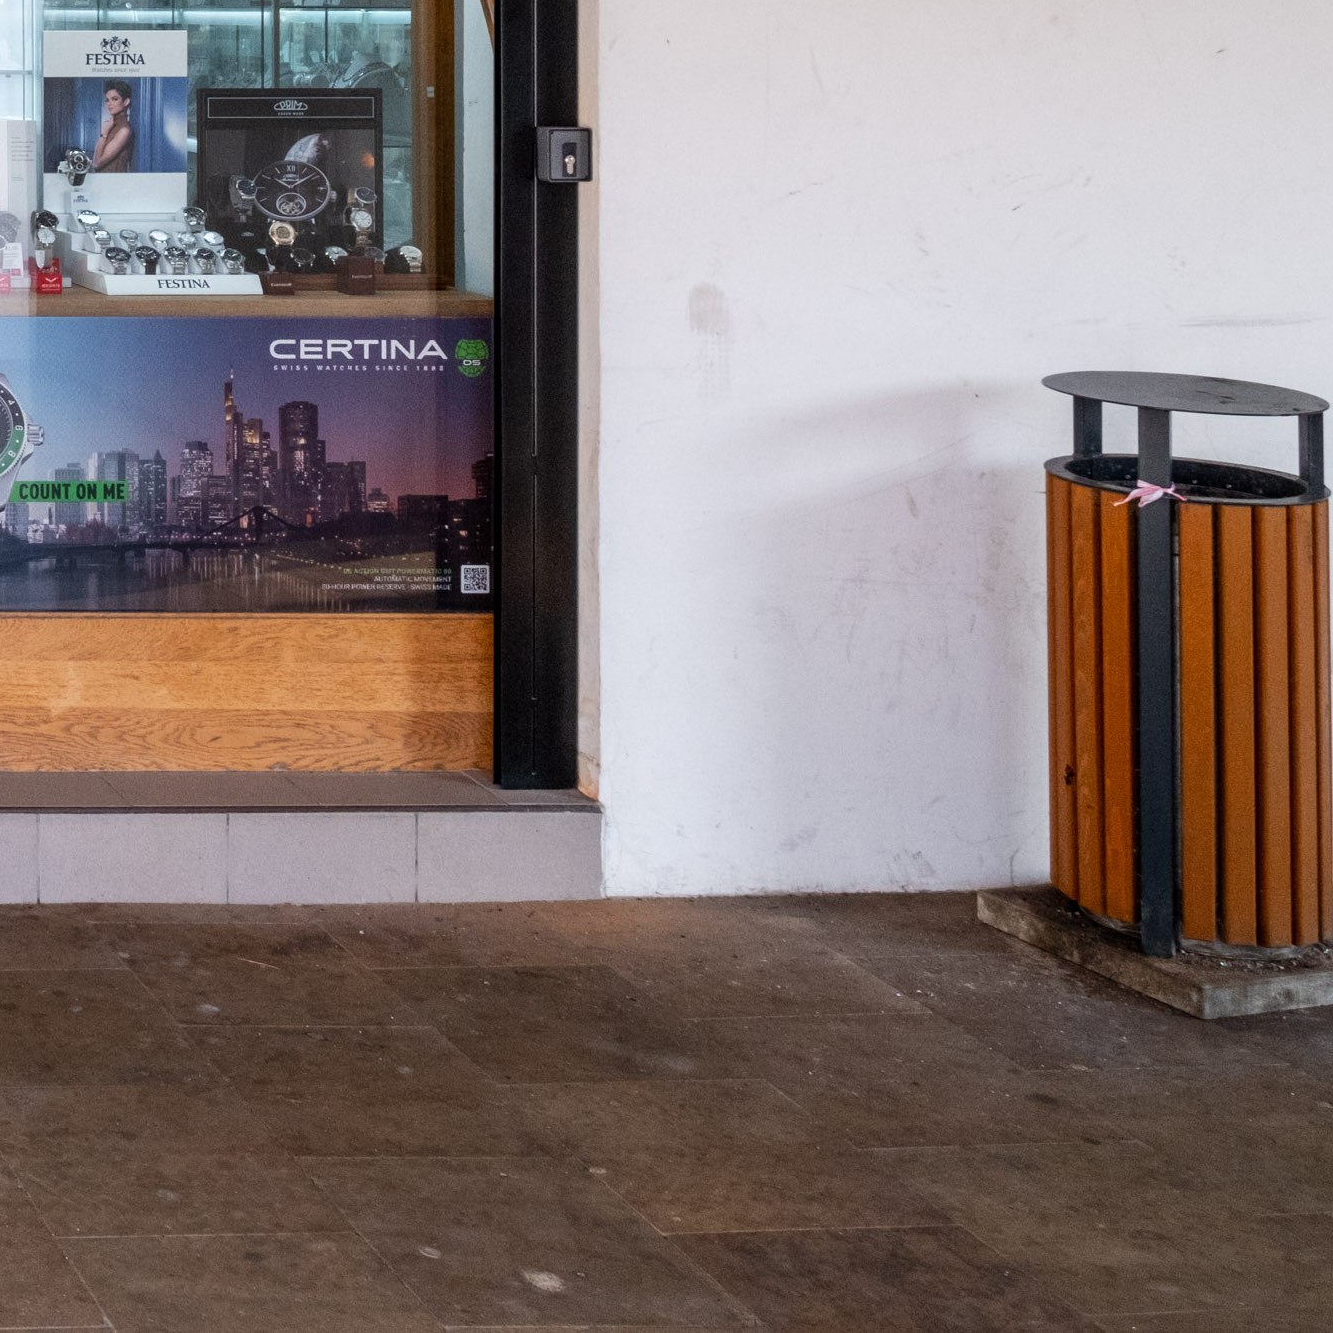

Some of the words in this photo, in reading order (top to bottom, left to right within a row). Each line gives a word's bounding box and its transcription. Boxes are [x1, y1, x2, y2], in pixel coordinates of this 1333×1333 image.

[85, 53, 146, 65] FESTINA
[279, 100, 303, 111] PRIM
[156, 278, 211, 289] FESTINA
[269, 339, 448, 360] CERTINA
[18, 483, 71, 500] COUNT
[76, 483, 97, 500] ON
[103, 483, 126, 500] ME
